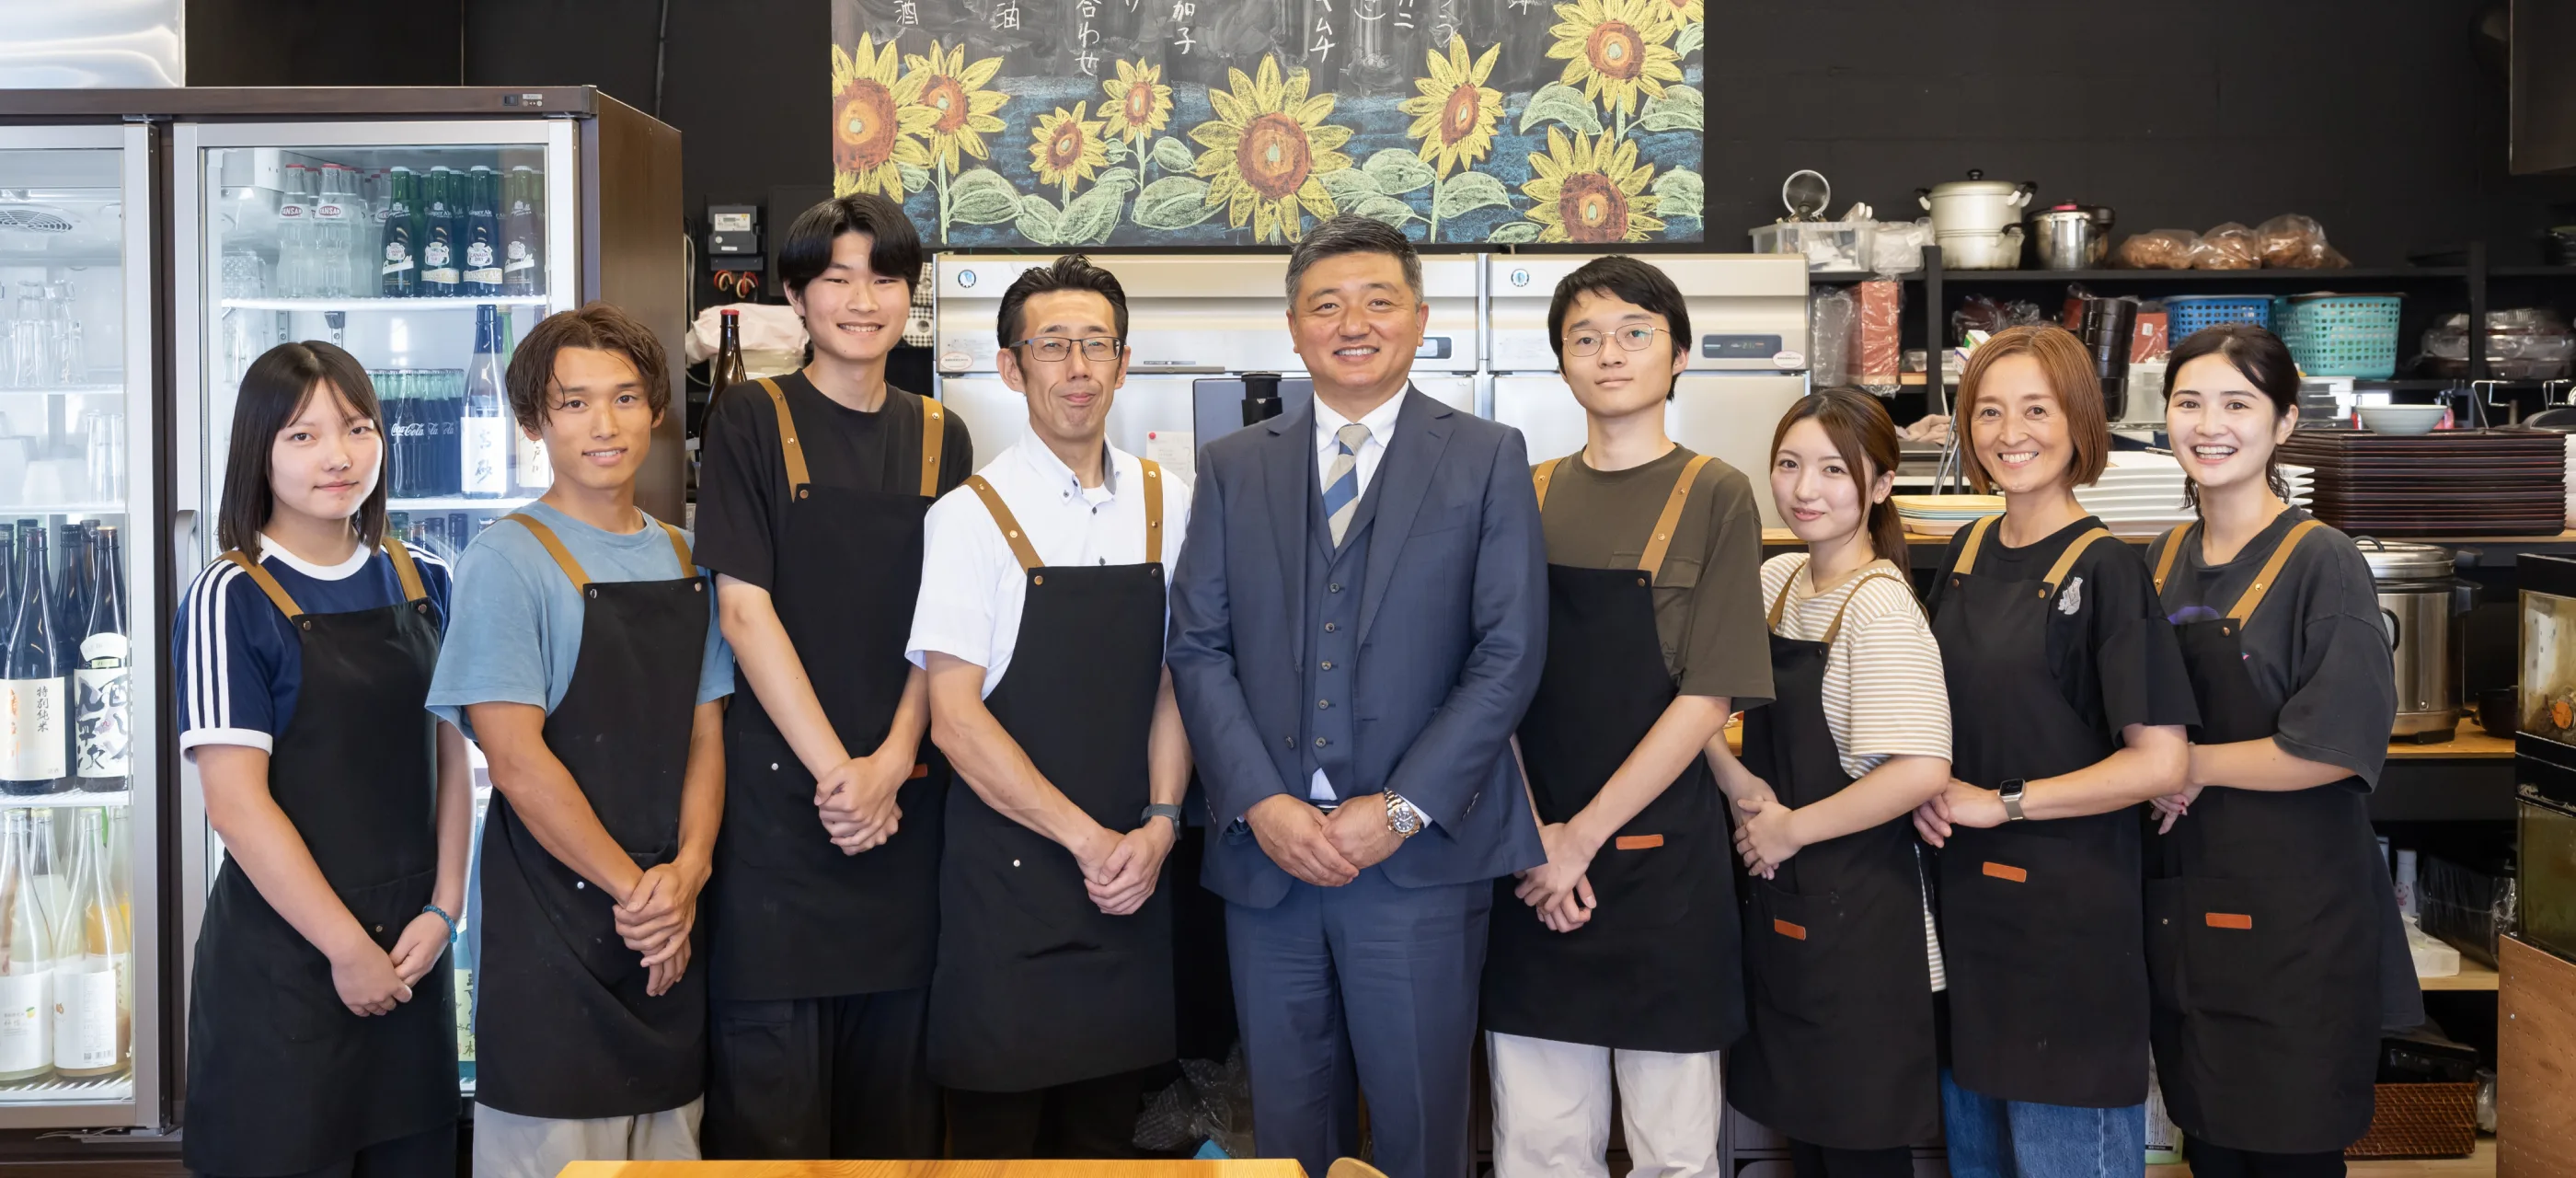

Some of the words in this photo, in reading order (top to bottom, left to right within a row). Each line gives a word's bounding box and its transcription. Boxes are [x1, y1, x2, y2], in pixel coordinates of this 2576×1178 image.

[893, 0, 919, 25] 酒
[995, 2, 1019, 30] 油
[1310, 0, 1335, 63] ムチ
[1075, 0, 1102, 76] 合わせ
[391, 422, 424, 436] Coca-Cola
[36, 685, 50, 733] 特別純米
